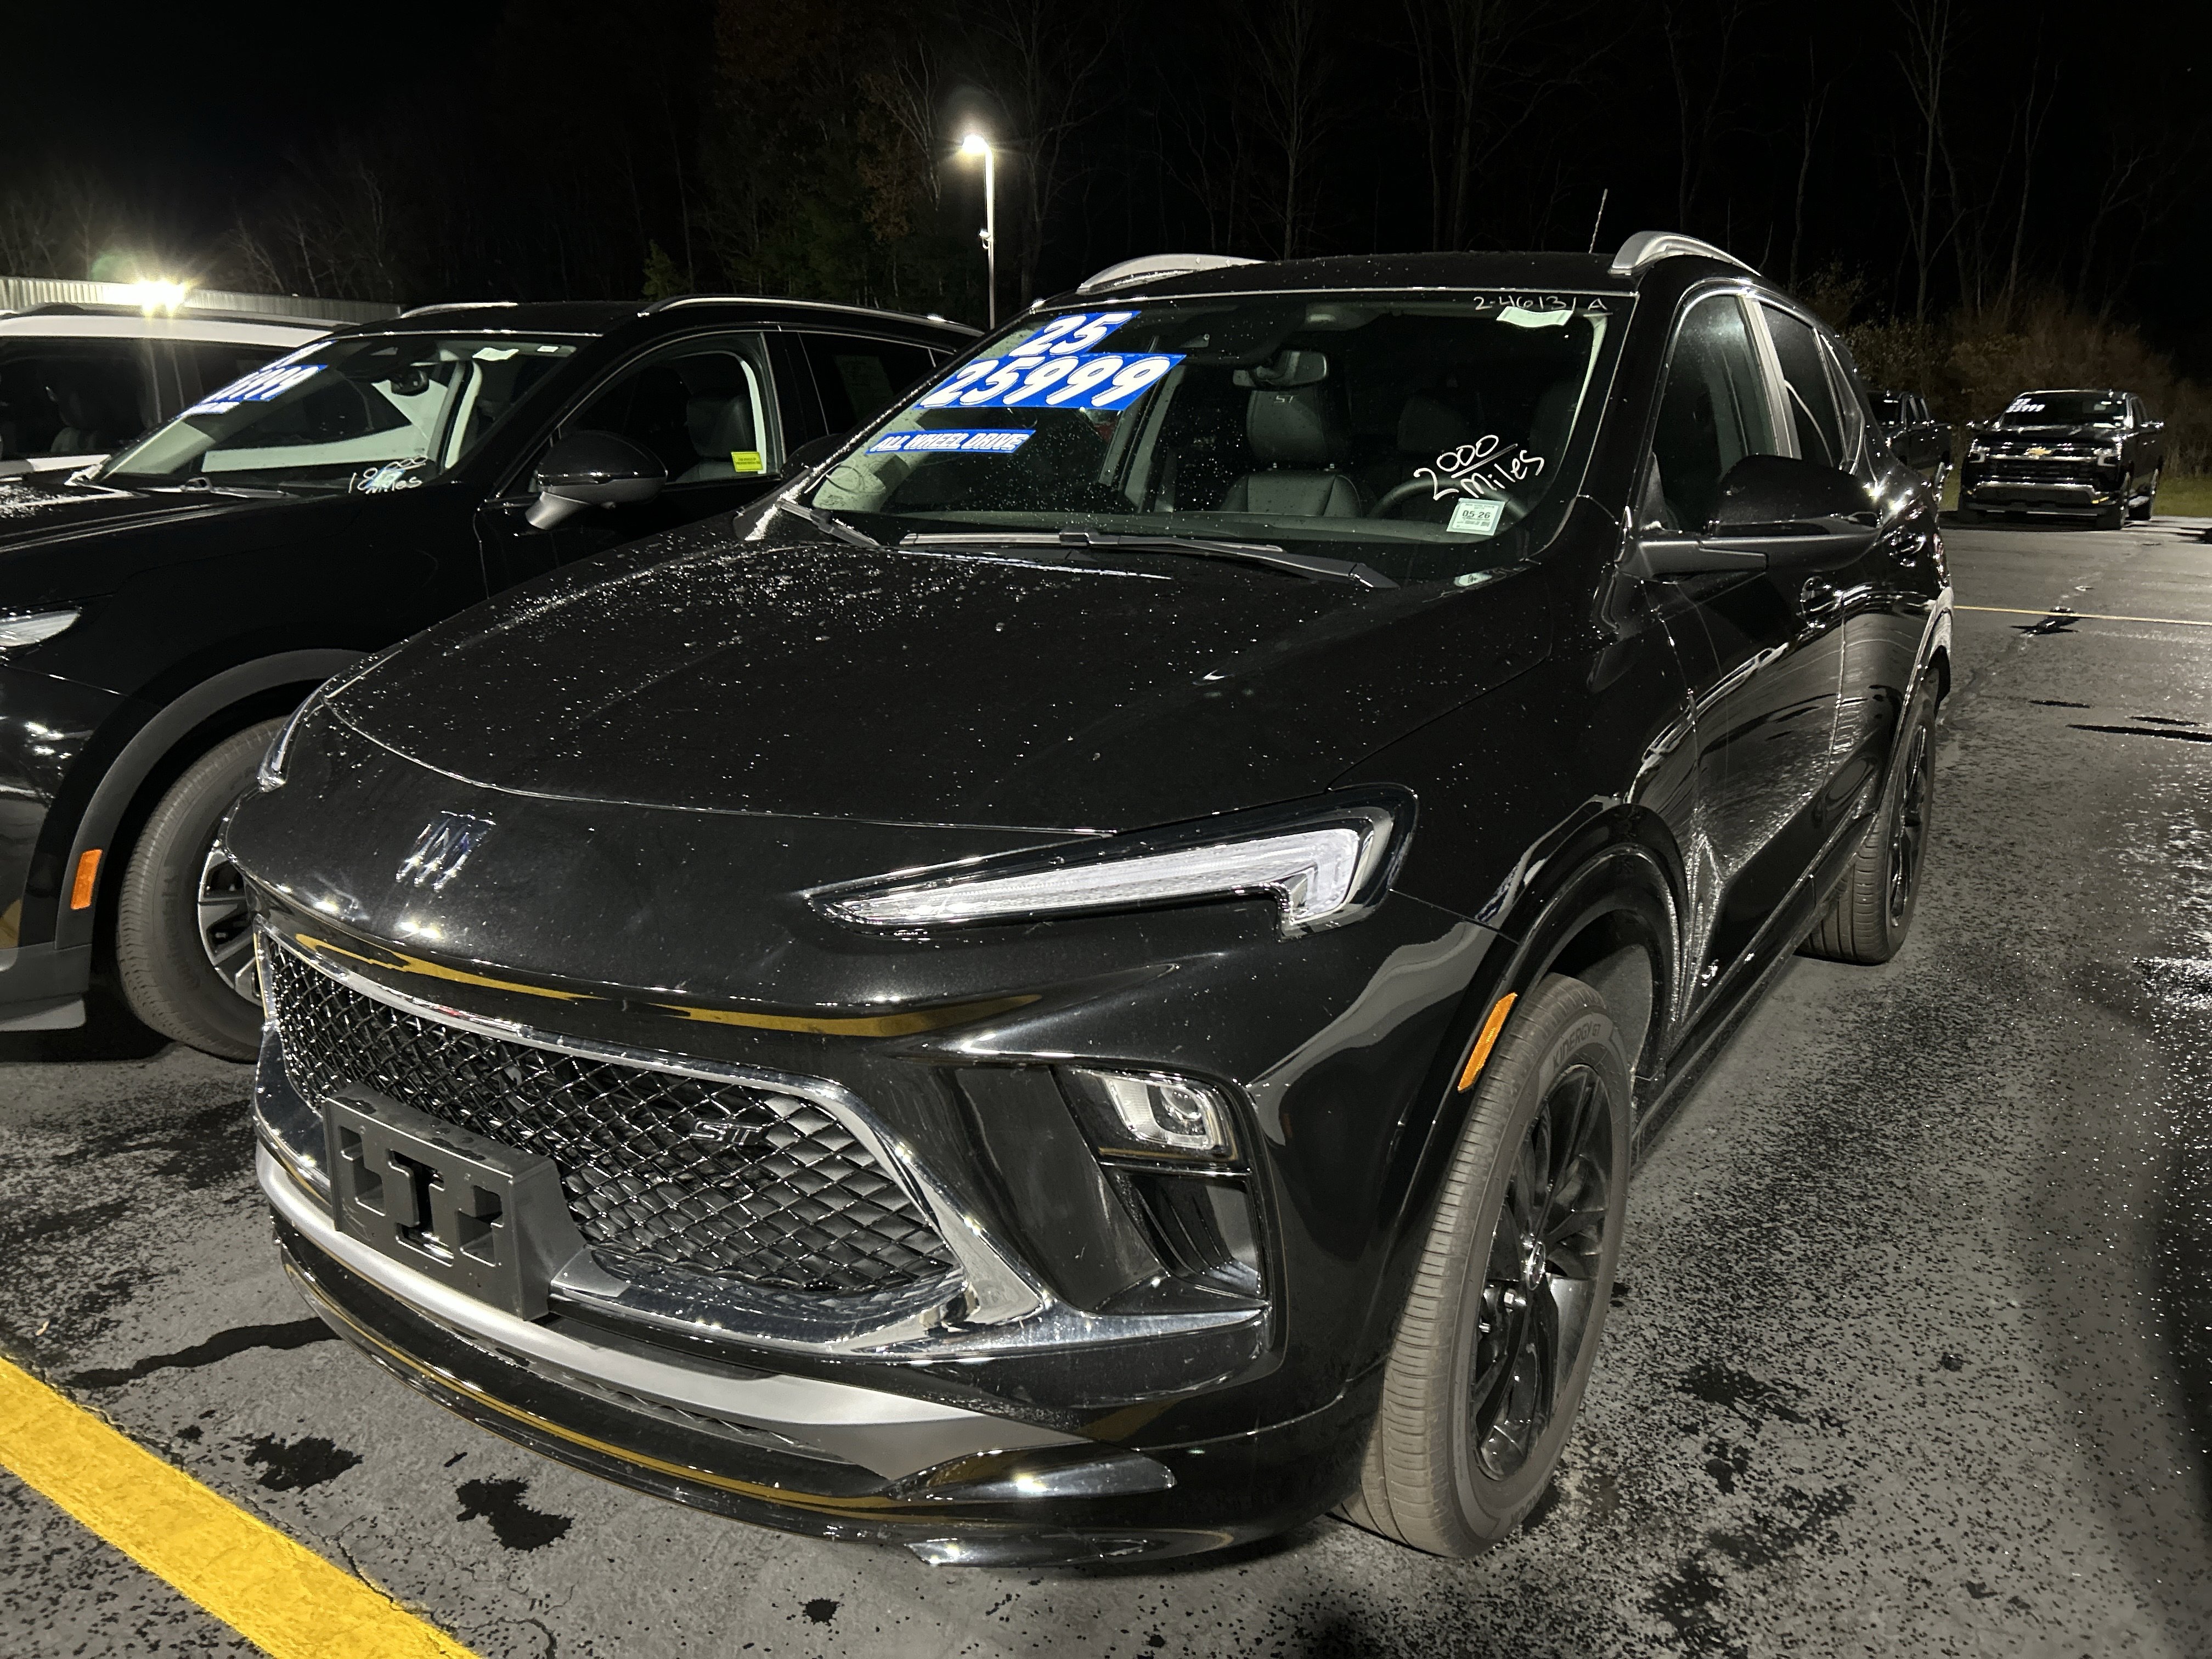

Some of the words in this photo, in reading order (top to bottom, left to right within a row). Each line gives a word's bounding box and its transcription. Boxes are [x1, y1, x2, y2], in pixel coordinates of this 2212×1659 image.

[1008, 312, 1135, 357] 25
[919, 356, 1171, 408] 25999
[869, 435, 911, 452] ALL
[903, 433, 969, 450] WHEEL
[961, 433, 1030, 451] DRIVE
[1413, 435, 1499, 501] 2000
[689, 1121, 763, 1146] ST
